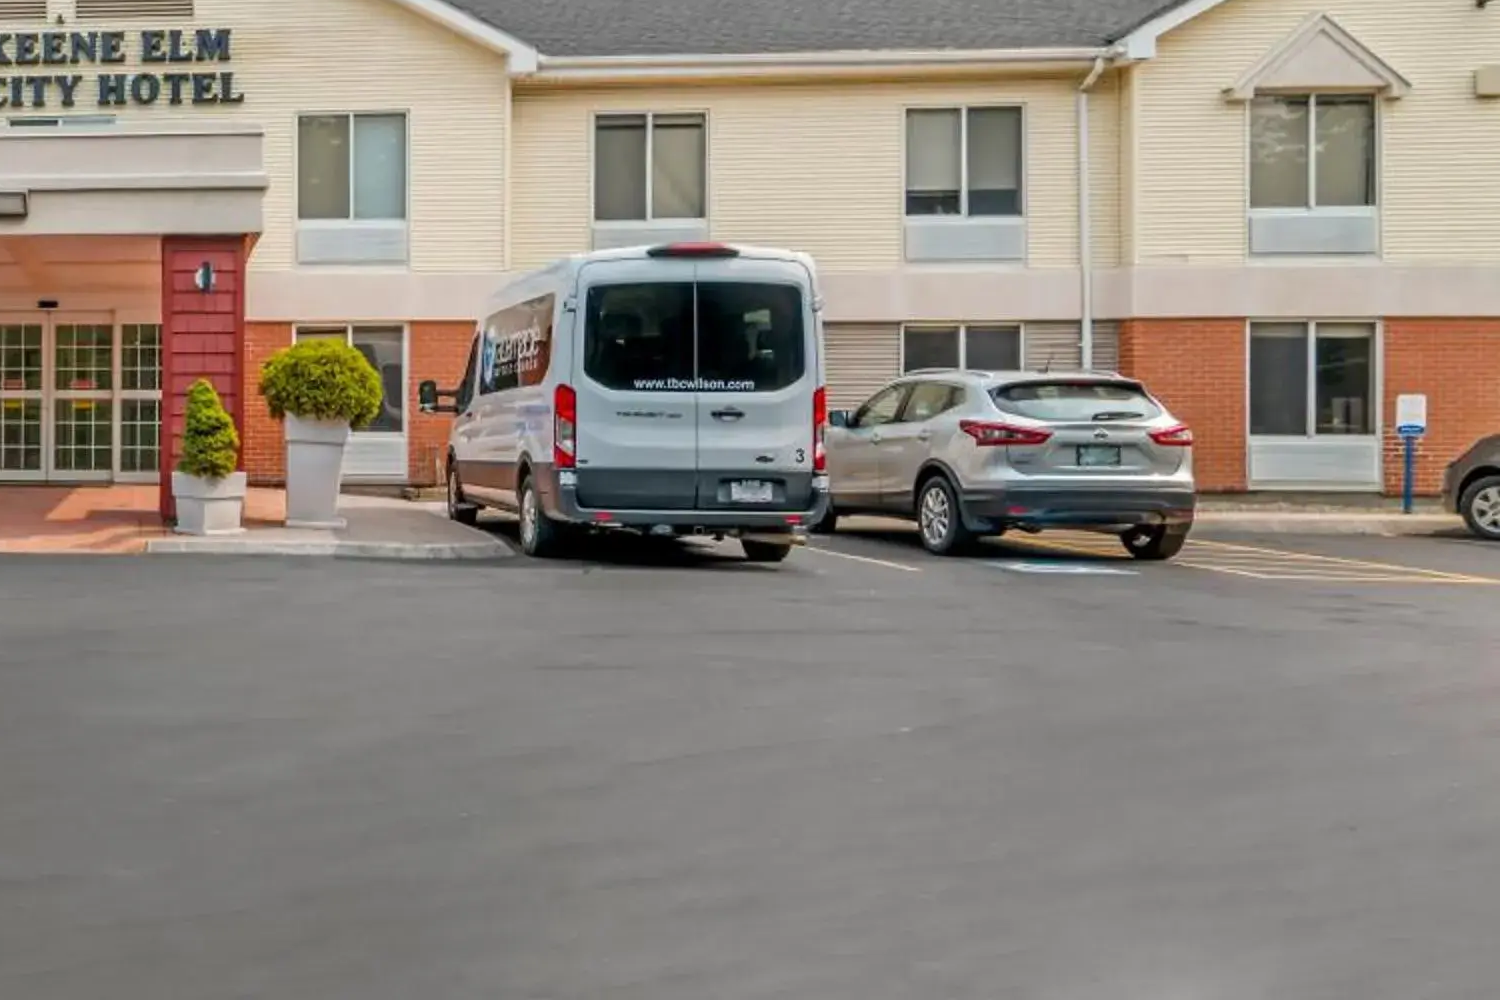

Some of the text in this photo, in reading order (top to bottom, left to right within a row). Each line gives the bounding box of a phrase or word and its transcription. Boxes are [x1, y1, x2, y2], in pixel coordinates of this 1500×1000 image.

[140, 29, 231, 63] ELM
[98, 72, 245, 107] HOTEL
[795, 447, 805, 464] 3
